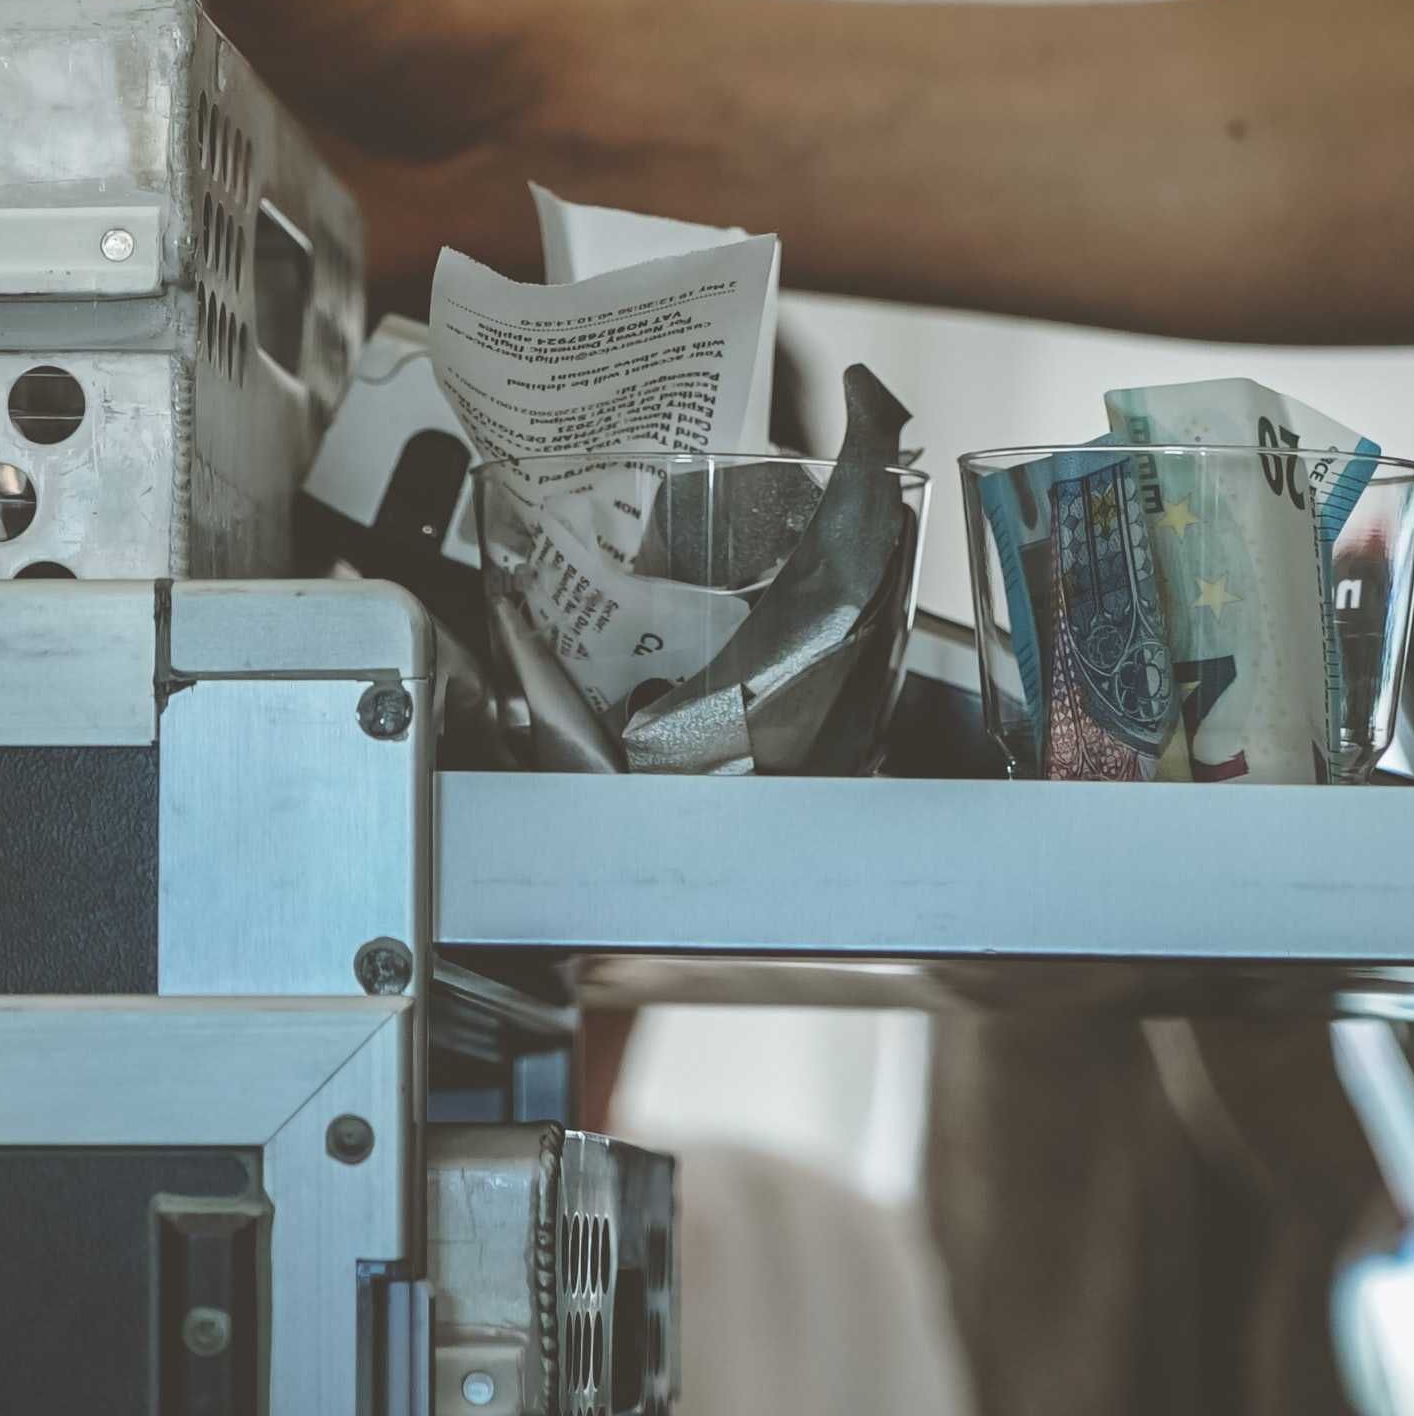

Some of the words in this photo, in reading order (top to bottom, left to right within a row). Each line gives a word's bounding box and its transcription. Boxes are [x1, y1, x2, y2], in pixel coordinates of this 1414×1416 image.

[698, 282, 725, 293] May
[653, 311, 681, 323] VAT
[668, 316, 692, 327] For
[477, 323, 532, 342] applies
[605, 324, 663, 342] Norway
[477, 331, 526, 353] flights
[530, 340, 601, 354] Domestic
[662, 344, 687, 355] the
[692, 339, 724, 350] with
[614, 352, 659, 367] above
[687, 349, 724, 359] Your
[624, 354, 684, 376] account
[550, 365, 610, 382] amount
[592, 371, 620, 386] will
[640, 371, 720, 388] Passenger
[507, 378, 566, 391] debited
[570, 378, 589, 389] be
[659, 389, 717, 404] Method
[666, 399, 714, 417] Expiry
[530, 414, 587, 425] Swiped
[677, 413, 711, 432] Card
[626, 431, 667, 448] Type:
[676, 426, 709, 446] Card
